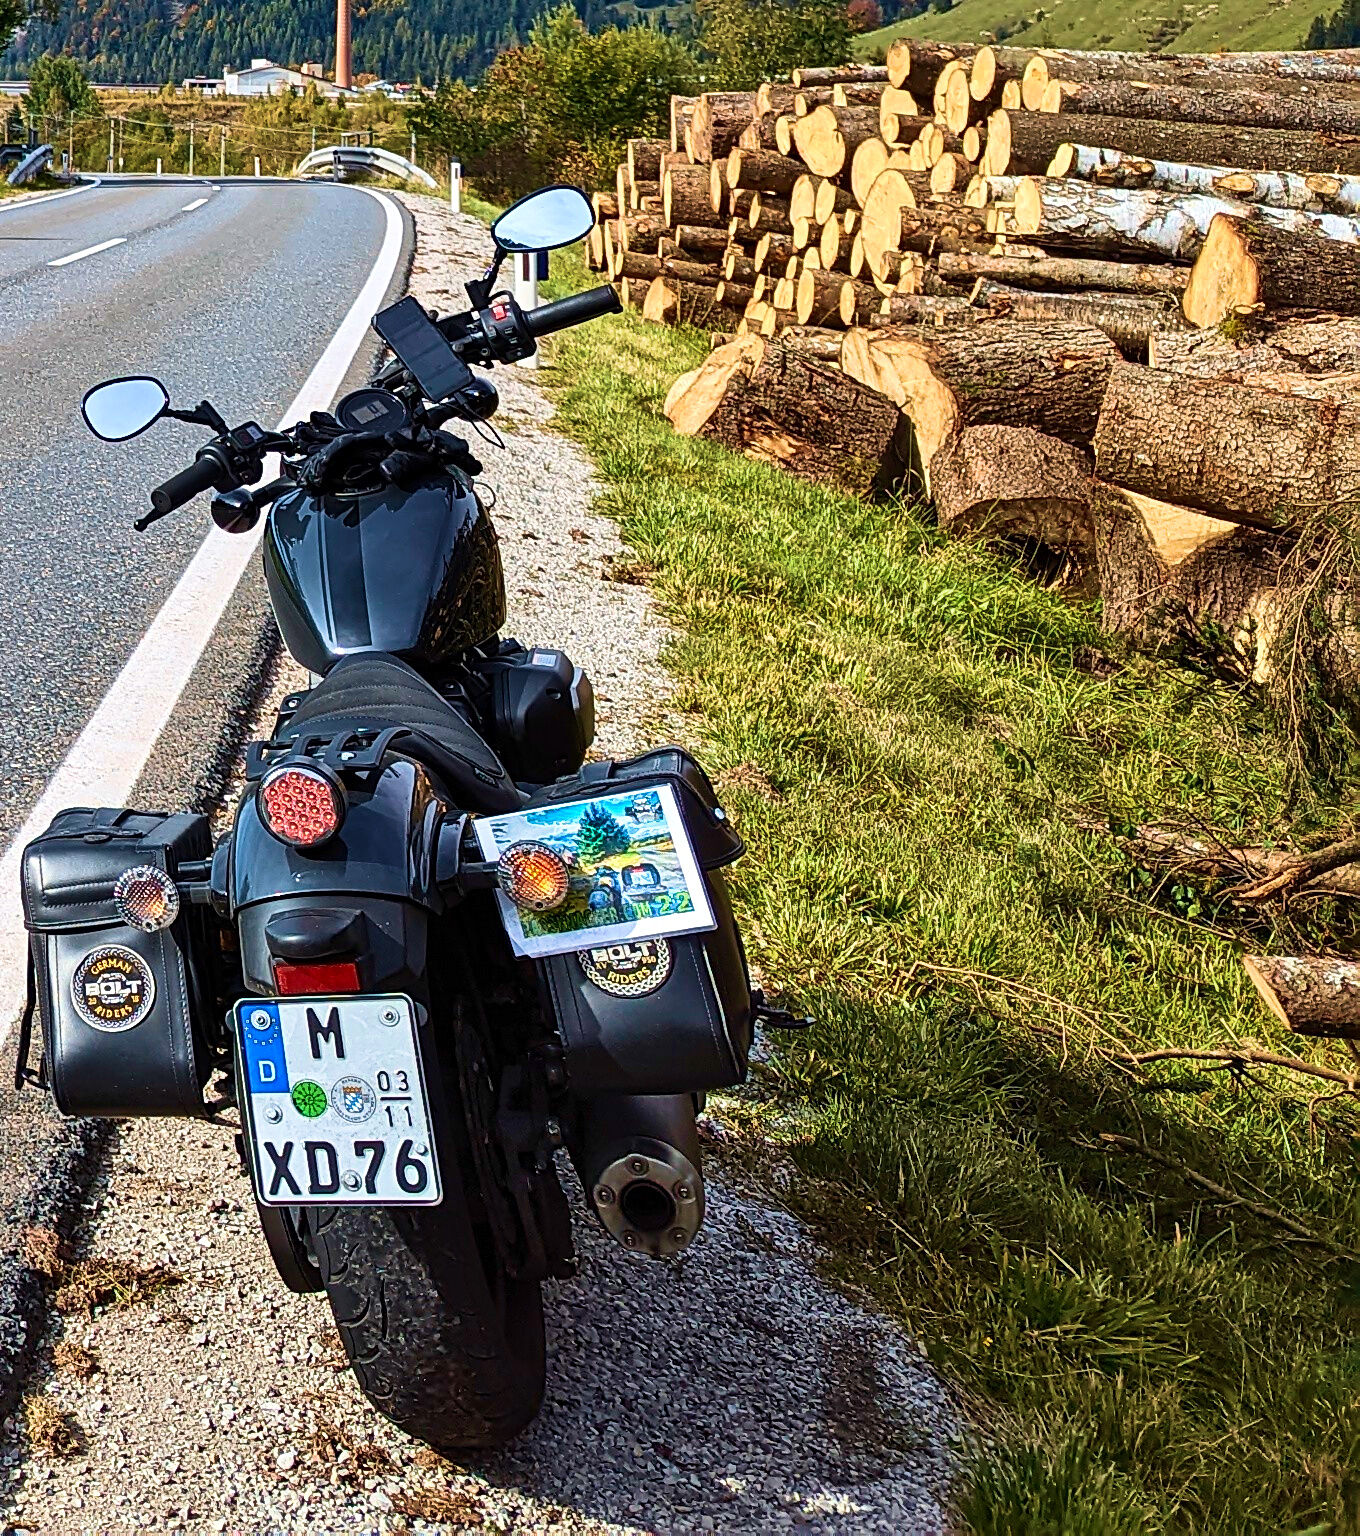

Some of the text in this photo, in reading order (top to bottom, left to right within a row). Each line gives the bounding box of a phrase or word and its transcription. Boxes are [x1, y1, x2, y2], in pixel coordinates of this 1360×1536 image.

[591, 942, 652, 962] BOLT
[90, 958, 132, 975] GERMAN
[607, 966, 651, 984] RIDERS
[85, 980, 141, 996] BOLT
[94, 1004, 133, 1018] RIDERS
[306, 1006, 345, 1059] M
[258, 1060, 276, 1082] D
[376, 1070, 409, 1092] 03
[384, 1105, 413, 1127] 11
[263, 1139, 428, 1195] XD 76
